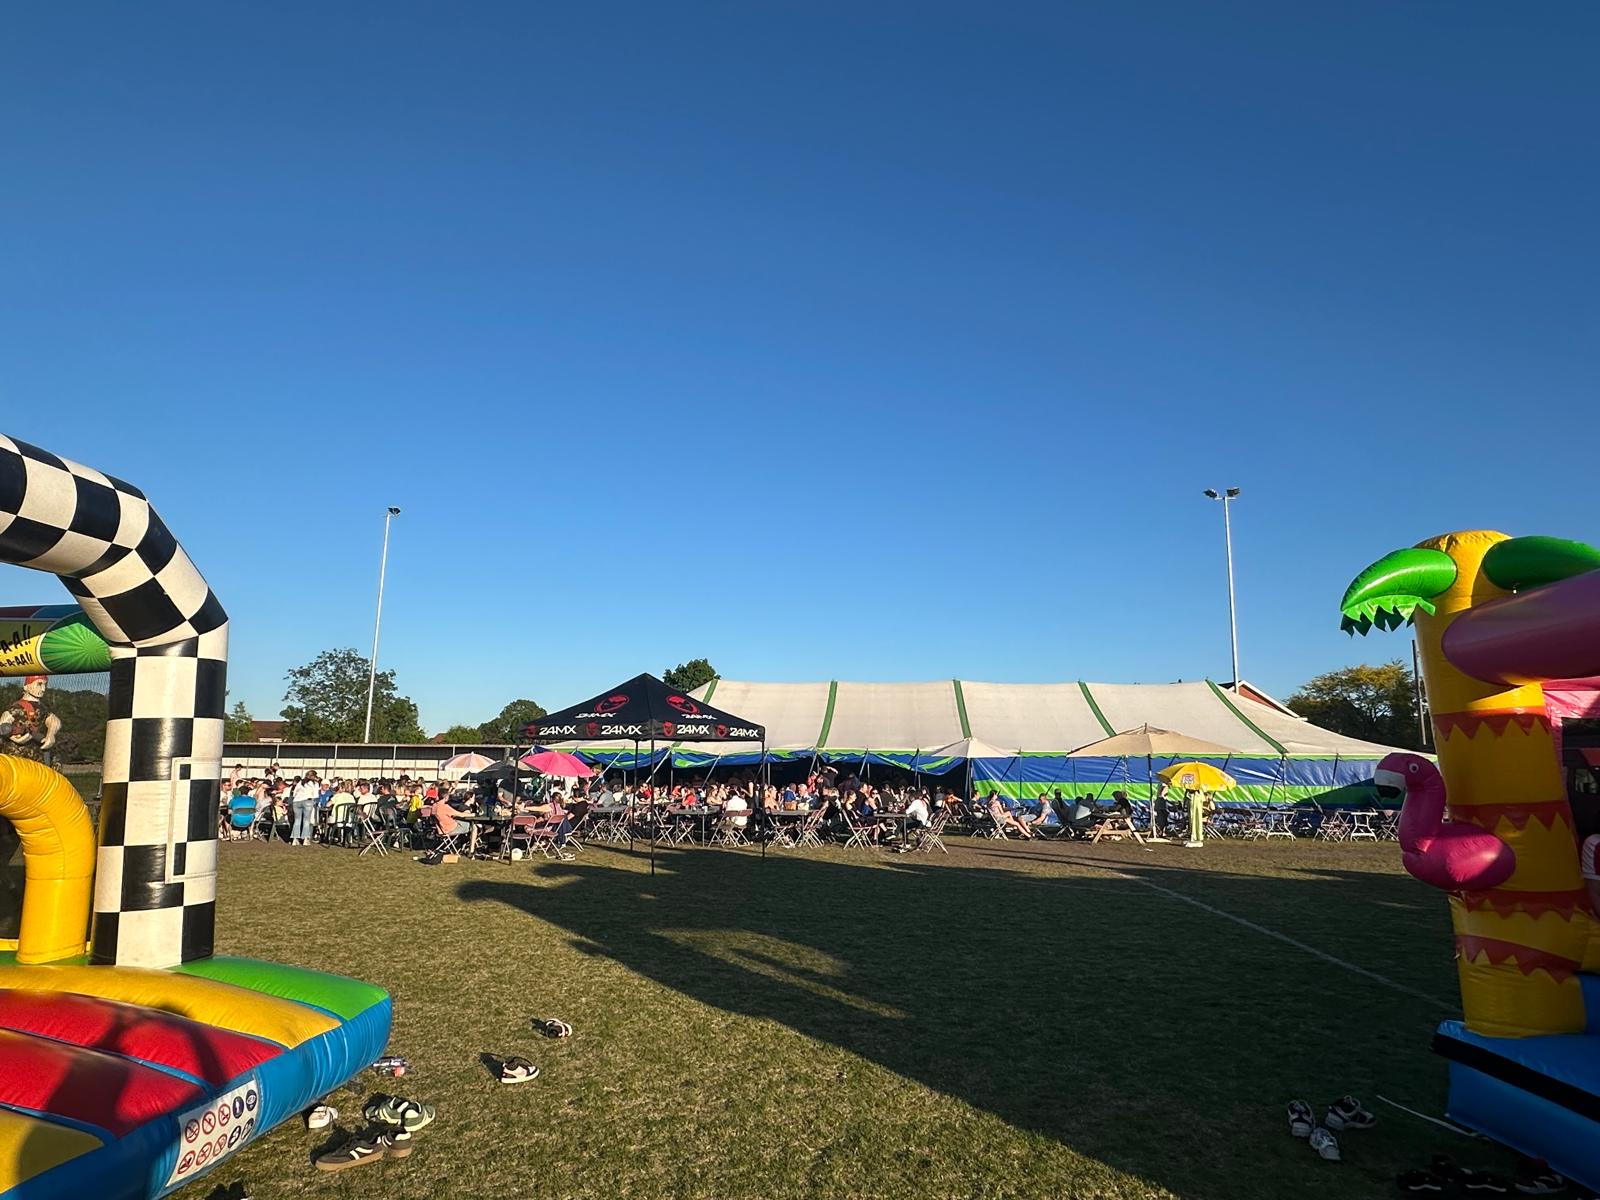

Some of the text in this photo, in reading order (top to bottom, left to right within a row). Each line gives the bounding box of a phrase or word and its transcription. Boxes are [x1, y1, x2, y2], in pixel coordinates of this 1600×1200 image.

[539, 725, 577, 736] 24MX
[601, 725, 643, 735] 24MX
[677, 724, 710, 735] 24MX
[730, 727, 759, 738] 24MX
